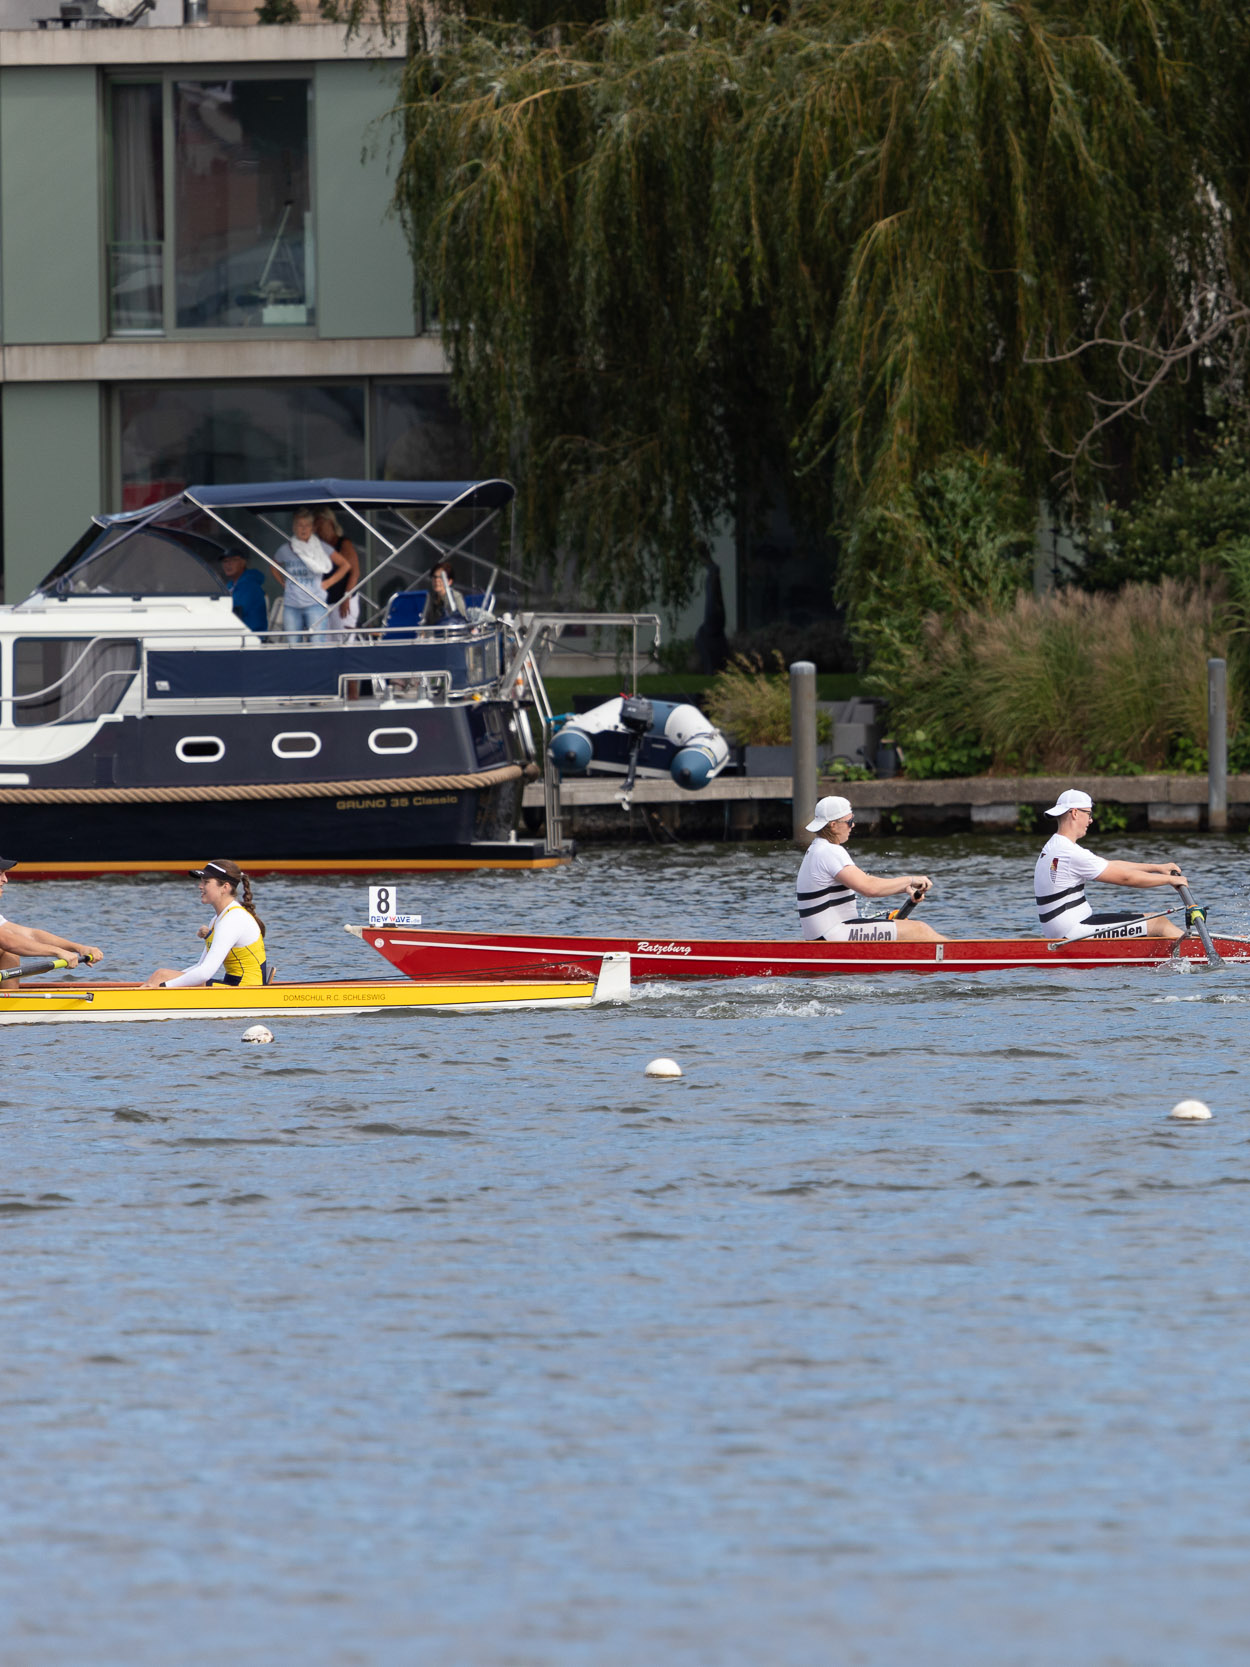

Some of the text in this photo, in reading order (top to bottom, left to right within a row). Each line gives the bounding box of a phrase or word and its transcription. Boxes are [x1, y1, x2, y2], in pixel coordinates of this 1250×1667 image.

[390, 798, 409, 807] 35
[413, 795, 458, 806] Classic
[377, 887, 390, 914] 8
[848, 926, 892, 941] Minden
[637, 941, 692, 955] Ratzeburg
[283, 993, 325, 1002] DOMSCHUL
[342, 993, 386, 1001] SCHLESWIG
